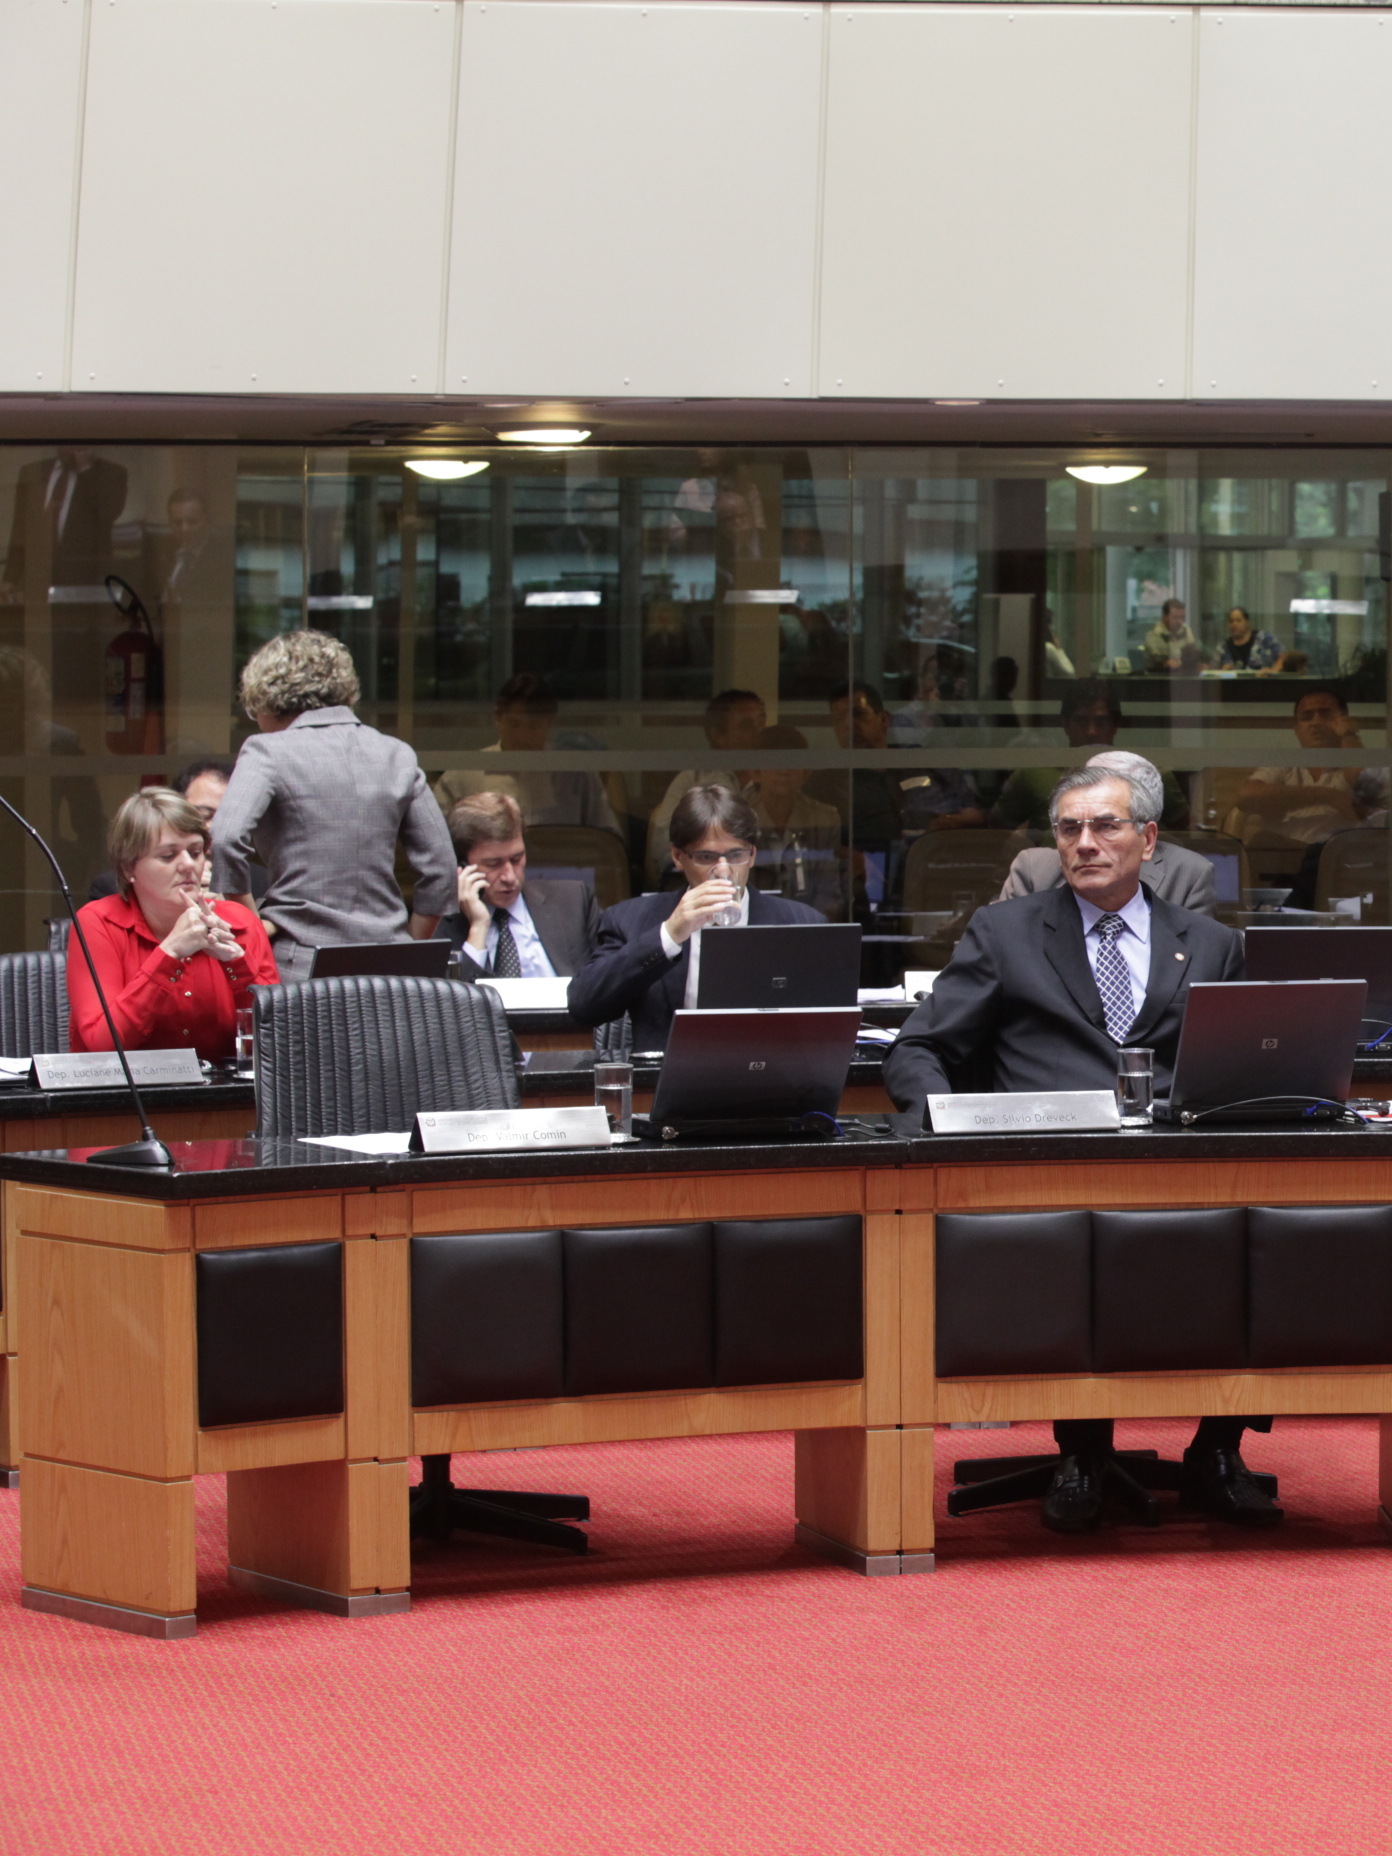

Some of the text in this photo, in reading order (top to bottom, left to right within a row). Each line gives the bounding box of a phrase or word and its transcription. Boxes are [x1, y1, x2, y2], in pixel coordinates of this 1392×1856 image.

[47, 1065, 195, 1080] Dep. Luciane Mia Carminatti
[974, 1112, 1078, 1126] Dep. Silvio Dreveck
[495, 1131, 529, 1141] Valmir
[533, 1129, 567, 1140] Comin
